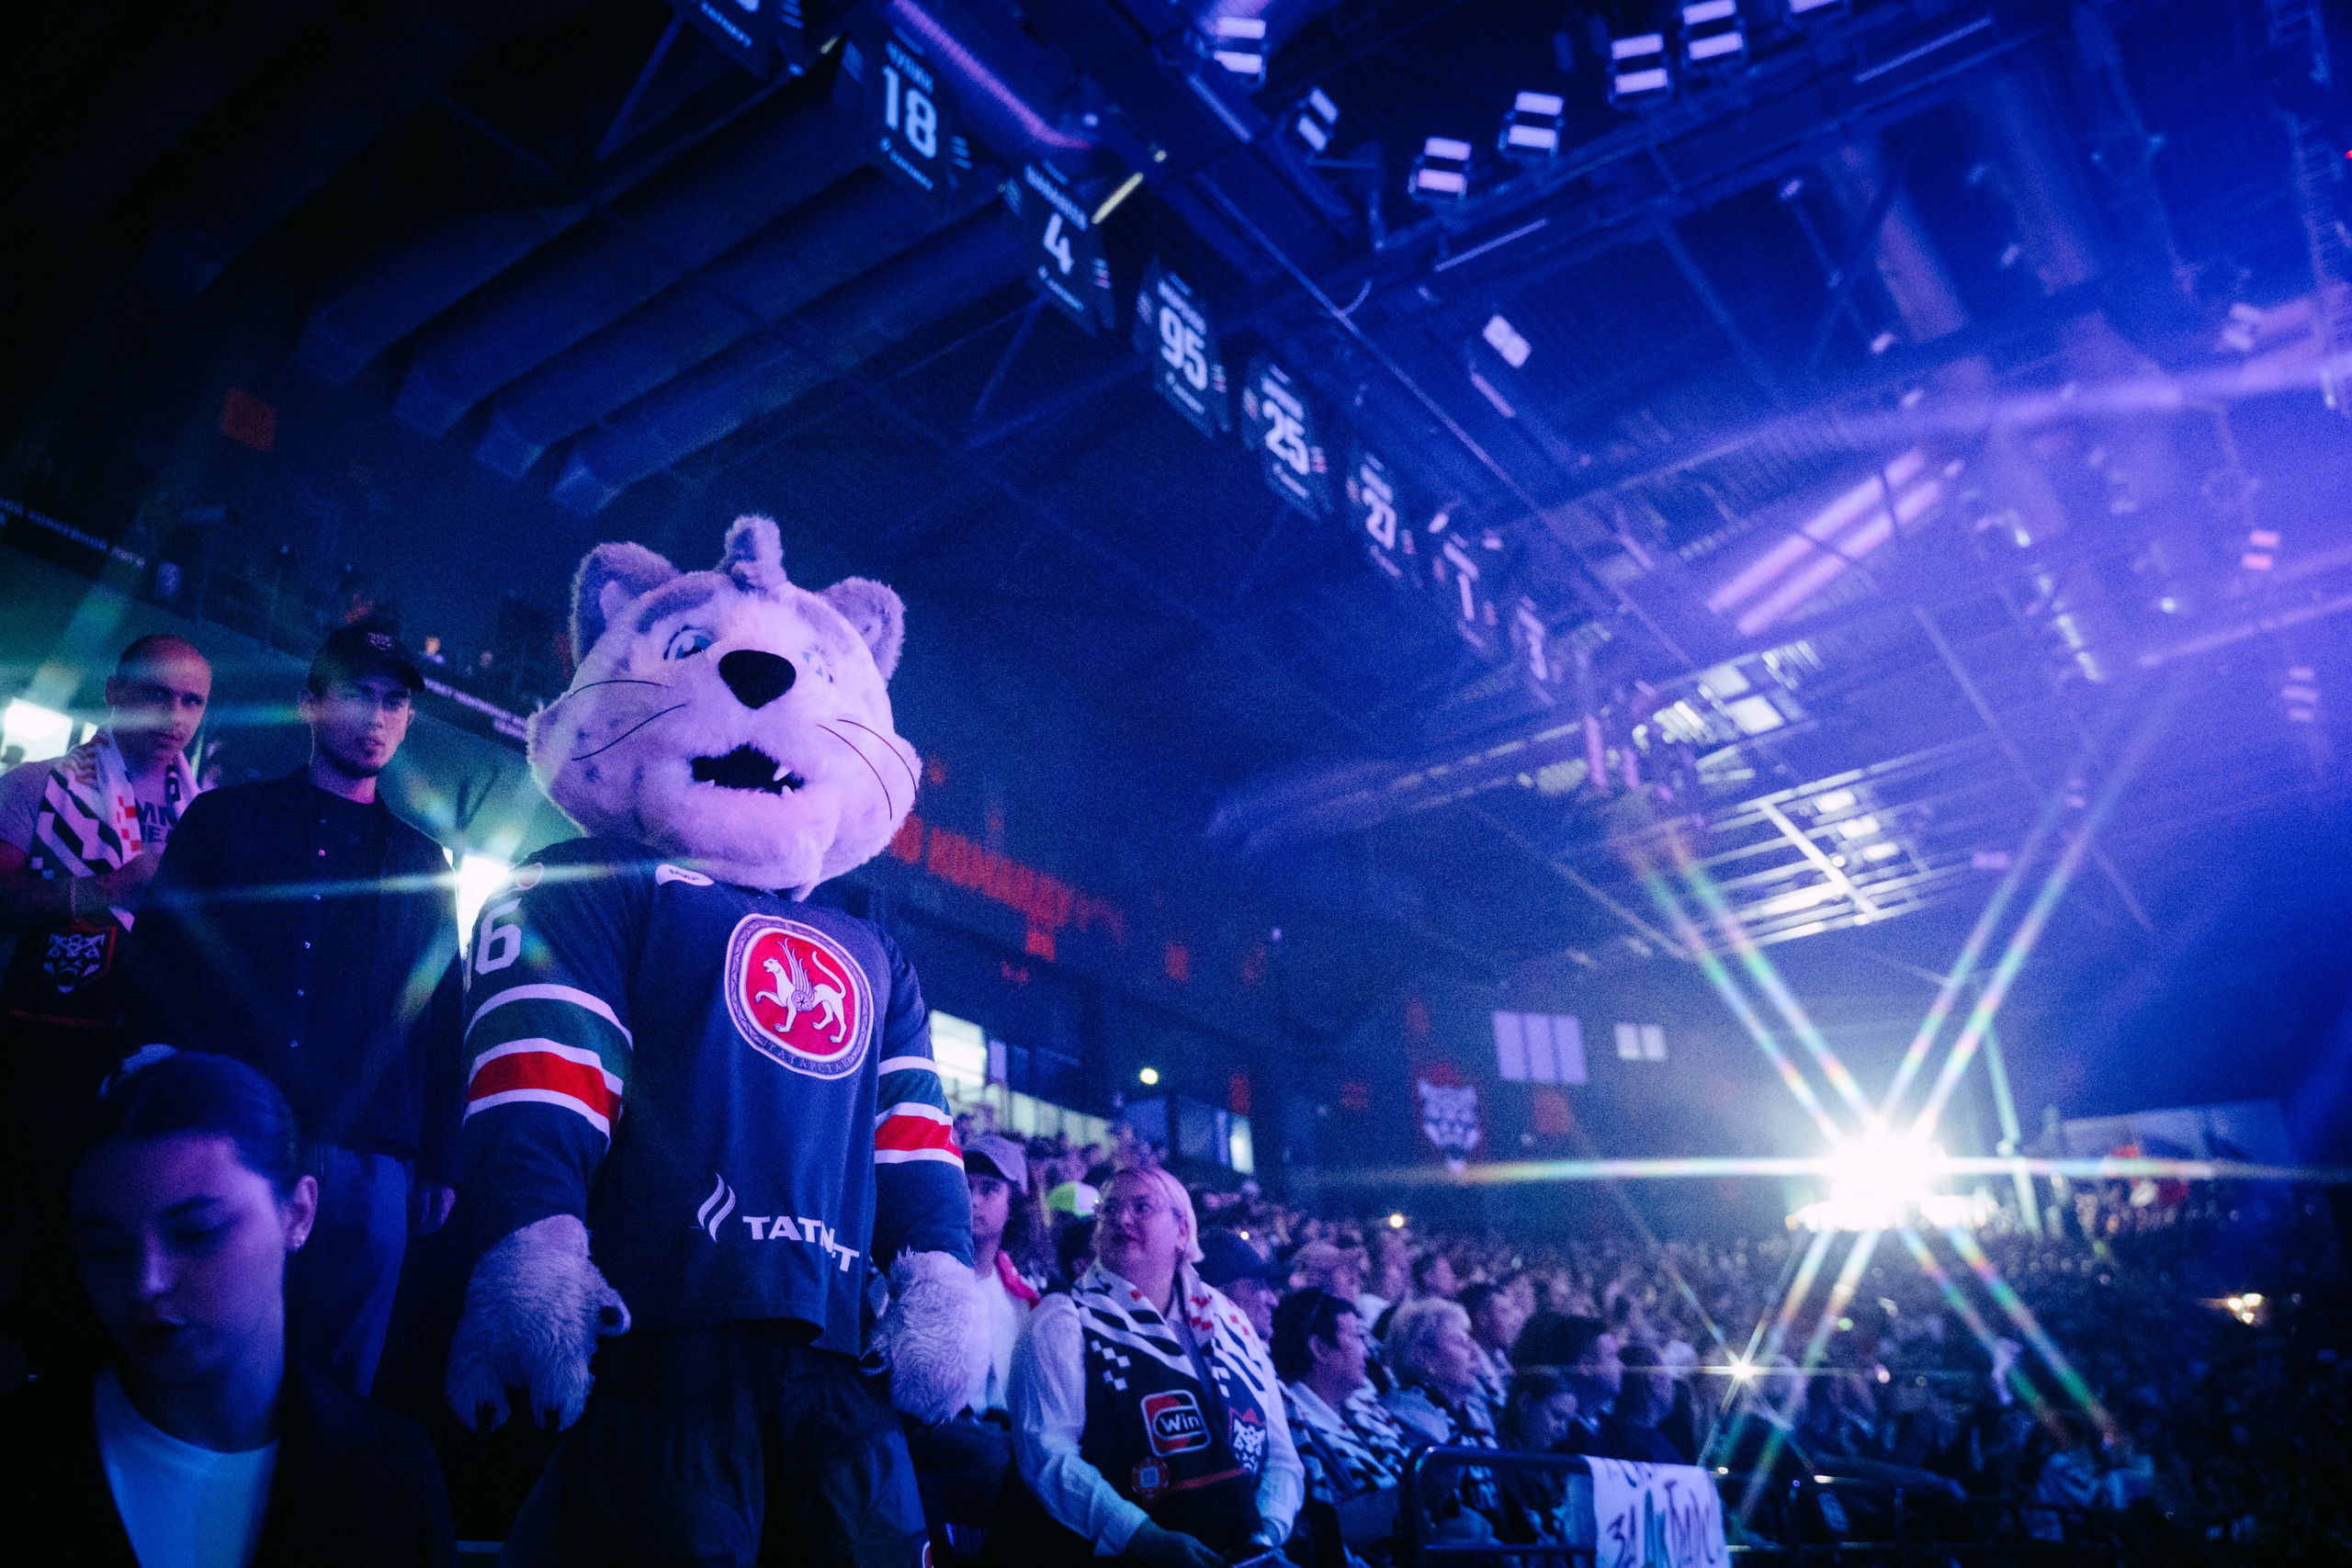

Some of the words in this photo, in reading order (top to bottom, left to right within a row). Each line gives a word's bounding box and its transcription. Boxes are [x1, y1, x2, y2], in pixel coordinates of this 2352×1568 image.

[883, 65, 937, 158] 18
[1043, 211, 1074, 275] 4
[1159, 307, 1208, 390] 95
[1262, 400, 1310, 476] 25
[463, 897, 522, 994] 6
